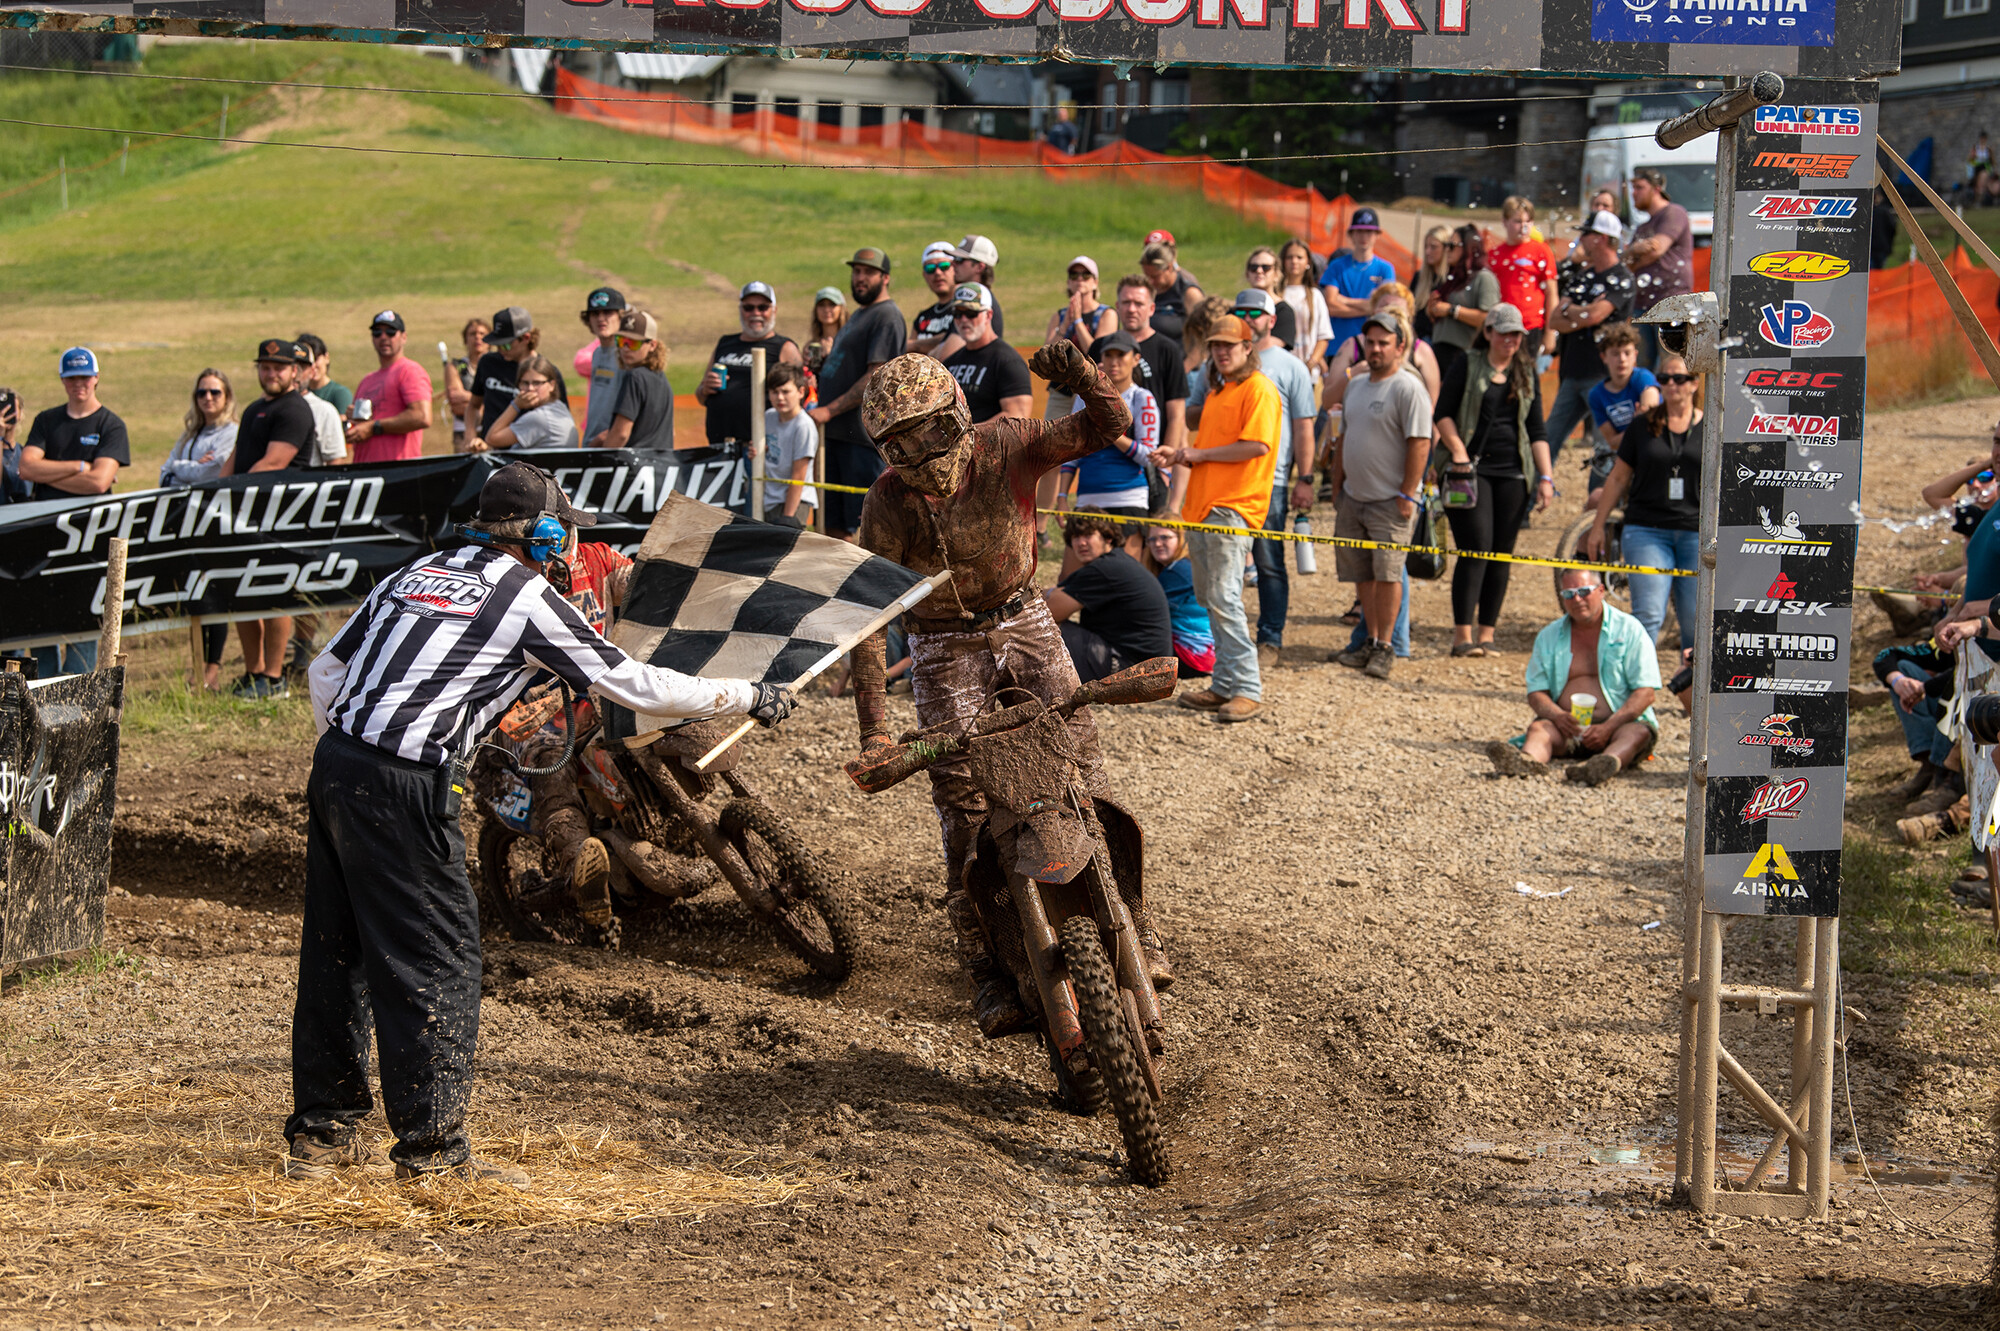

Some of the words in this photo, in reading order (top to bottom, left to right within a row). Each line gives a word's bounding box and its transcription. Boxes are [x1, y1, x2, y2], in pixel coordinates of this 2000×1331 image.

[1634, 13, 1797, 27] RACING
[1755, 105, 1860, 125] PARTS
[1755, 121, 1860, 135] UNLIMITED
[1752, 151, 1860, 170] MOOSE
[1792, 168, 1847, 179] RACING
[1752, 196, 1857, 219] AMSOIL
[1805, 225, 1853, 234] Synthetics
[1750, 255, 1850, 275] FMF
[1761, 301, 1812, 346] VP
[1794, 325, 1835, 339] Racing
[1744, 369, 1843, 389] GBC
[1752, 388, 1803, 396] POWERSPORTS
[1748, 415, 1839, 435] KENDA
[1802, 435, 1837, 446] TIRES
[1756, 469, 1844, 483] DUNLOP
[1753, 479, 1808, 488] MOTORCYCLE
[1810, 481, 1836, 489] TIRES
[47, 477, 385, 557] SPECIALIZED
[1740, 543, 1831, 557] MICHELIN
[394, 573, 487, 606] GNCC
[1733, 598, 1833, 617] TUSK
[1727, 632, 1836, 652] METHOD
[1726, 648, 1764, 657] RACE
[1773, 650, 1836, 660] WHEELS
[1754, 677, 1833, 692] WISECO
[1740, 734, 1767, 745] ALL
[1767, 736, 1815, 748] BALLS
[1732, 881, 1810, 899] ARMA
